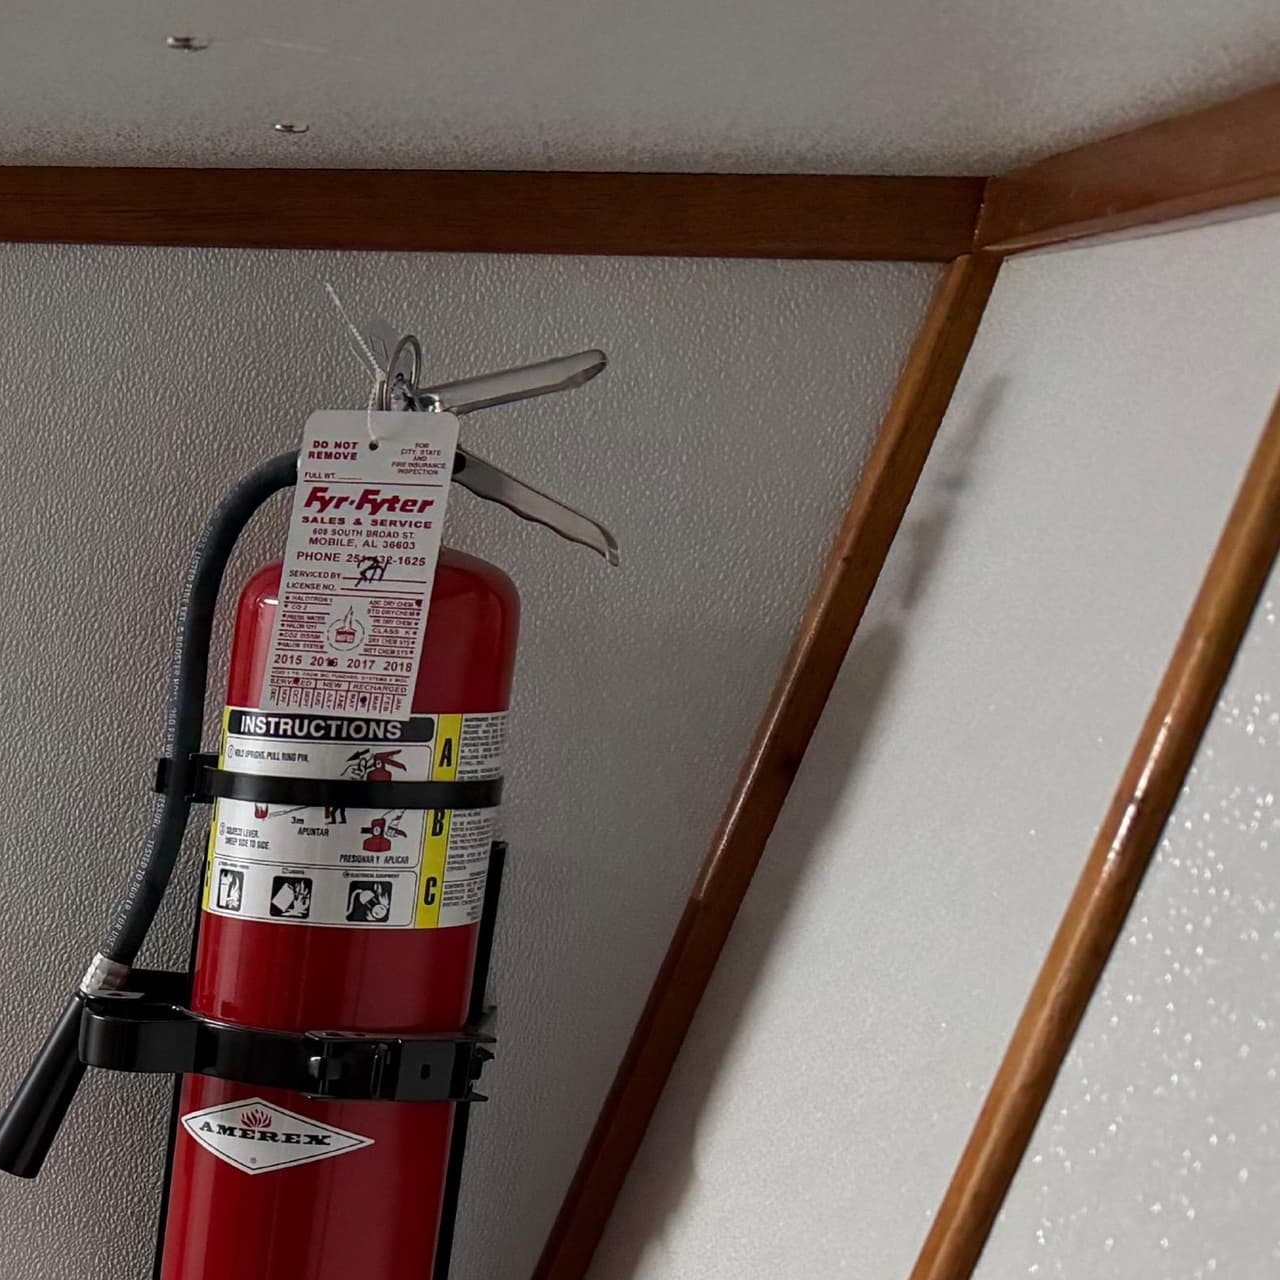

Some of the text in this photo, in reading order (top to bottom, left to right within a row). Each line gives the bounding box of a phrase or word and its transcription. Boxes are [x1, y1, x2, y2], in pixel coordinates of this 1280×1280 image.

[312, 440, 359, 450] DO NOT
[308, 451, 358, 460] REMOVE
[301, 516, 432, 529] SALES & SERVICE
[330, 528, 363, 537] SOUTH
[366, 530, 400, 538] BROAD
[308, 537, 416, 549] MOBILE, AL 36603
[296, 551, 341, 562] PHONE
[289, 570, 329, 578] SERVICED
[286, 582, 321, 590] LICENSE
[273, 654, 302, 665] 2015
[347, 658, 376, 670] 2017
[384, 661, 413, 672] 2018
[322, 681, 342, 689] NEW
[352, 684, 407, 693] RECHARGED
[241, 715, 402, 739] INSTRUCTIONS
[439, 737, 452, 767] A
[291, 816, 304, 824] 3m
[431, 809, 445, 836] B
[297, 827, 329, 837] APUNTAR
[384, 856, 409, 864] APLICAR
[424, 876, 437, 905] C
[200, 1121, 332, 1146] AMEREX
